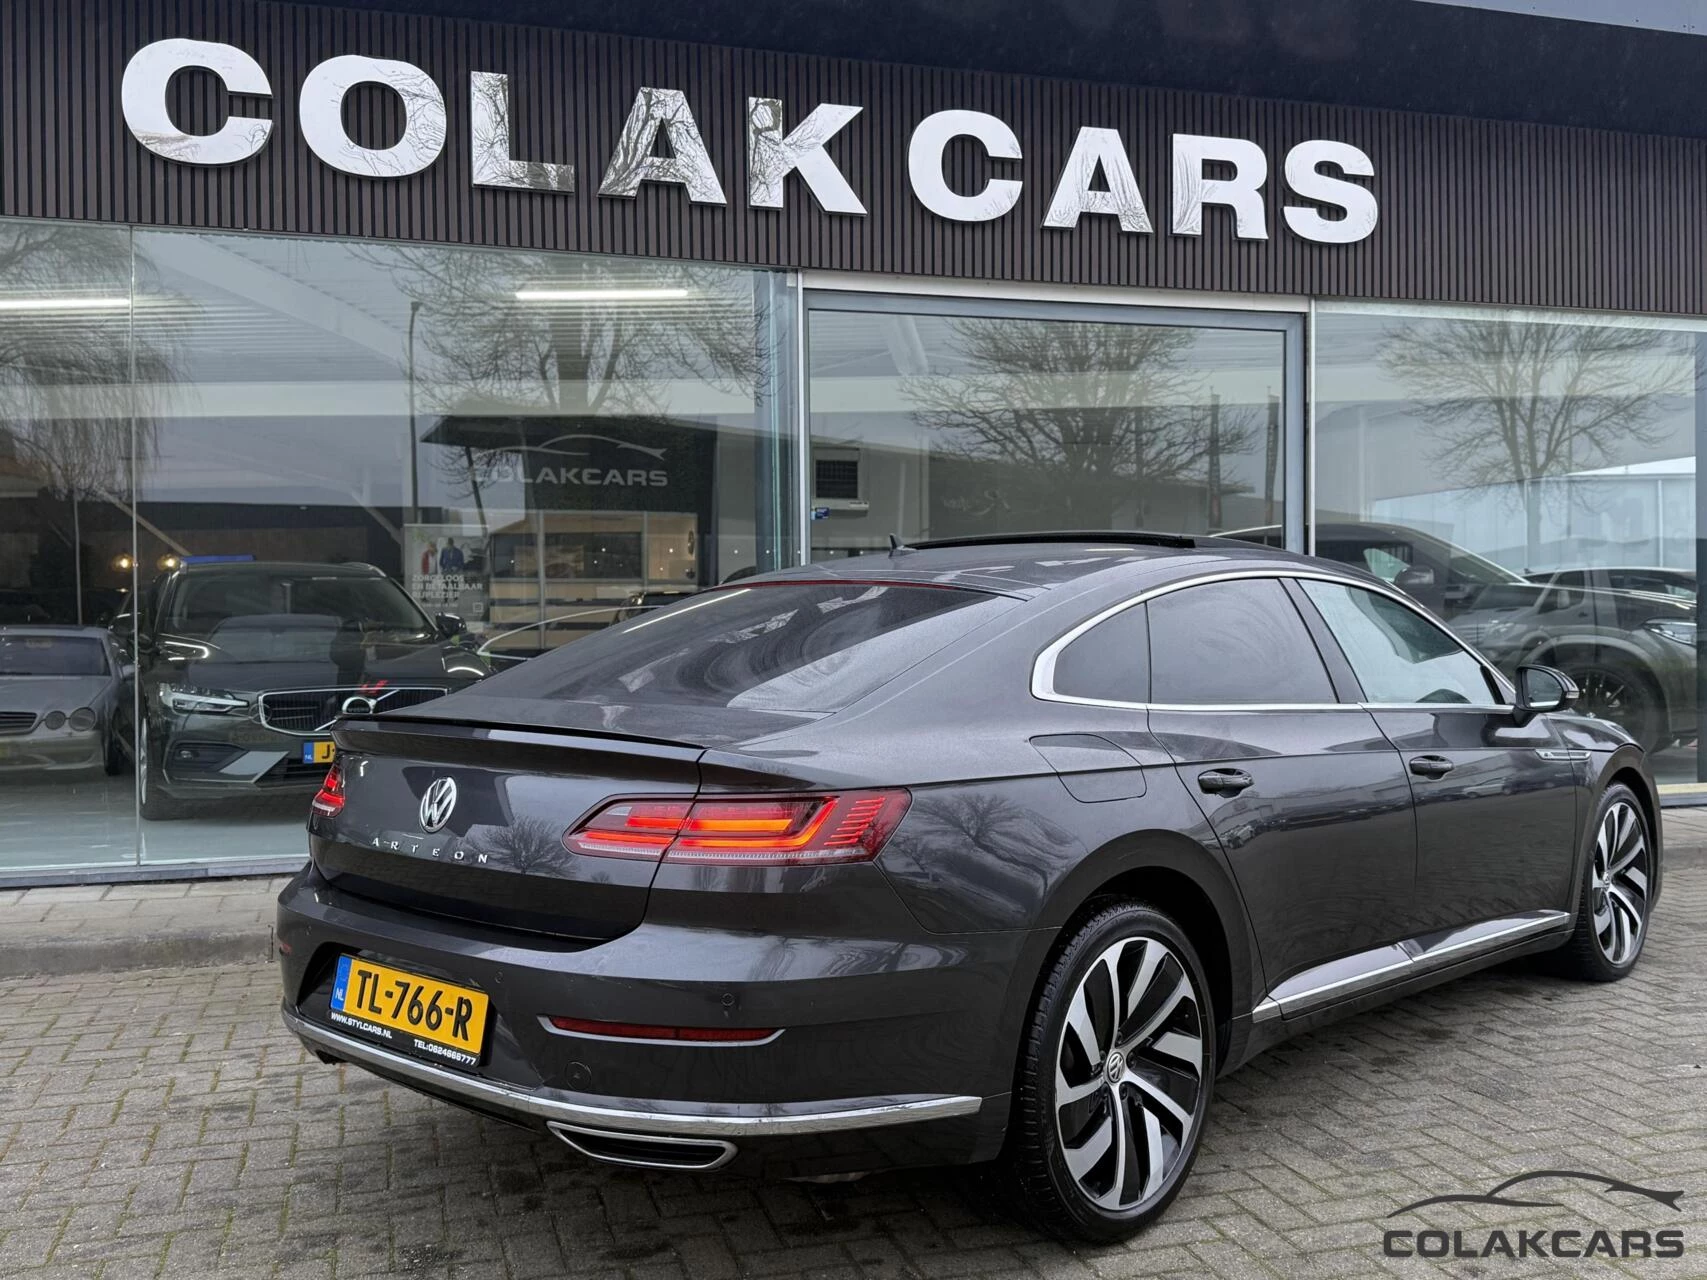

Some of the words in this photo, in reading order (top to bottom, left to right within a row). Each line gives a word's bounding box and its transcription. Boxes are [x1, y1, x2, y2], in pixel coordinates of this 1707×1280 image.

[121, 37, 868, 217] COLAK
[907, 108, 1380, 244] CARS
[372, 837, 488, 864] ARTEON
[331, 1011, 393, 1039] WWW.STYLCARS.NL
[335, 987, 345, 1001] NL
[356, 969, 473, 1042] TL-766-R
